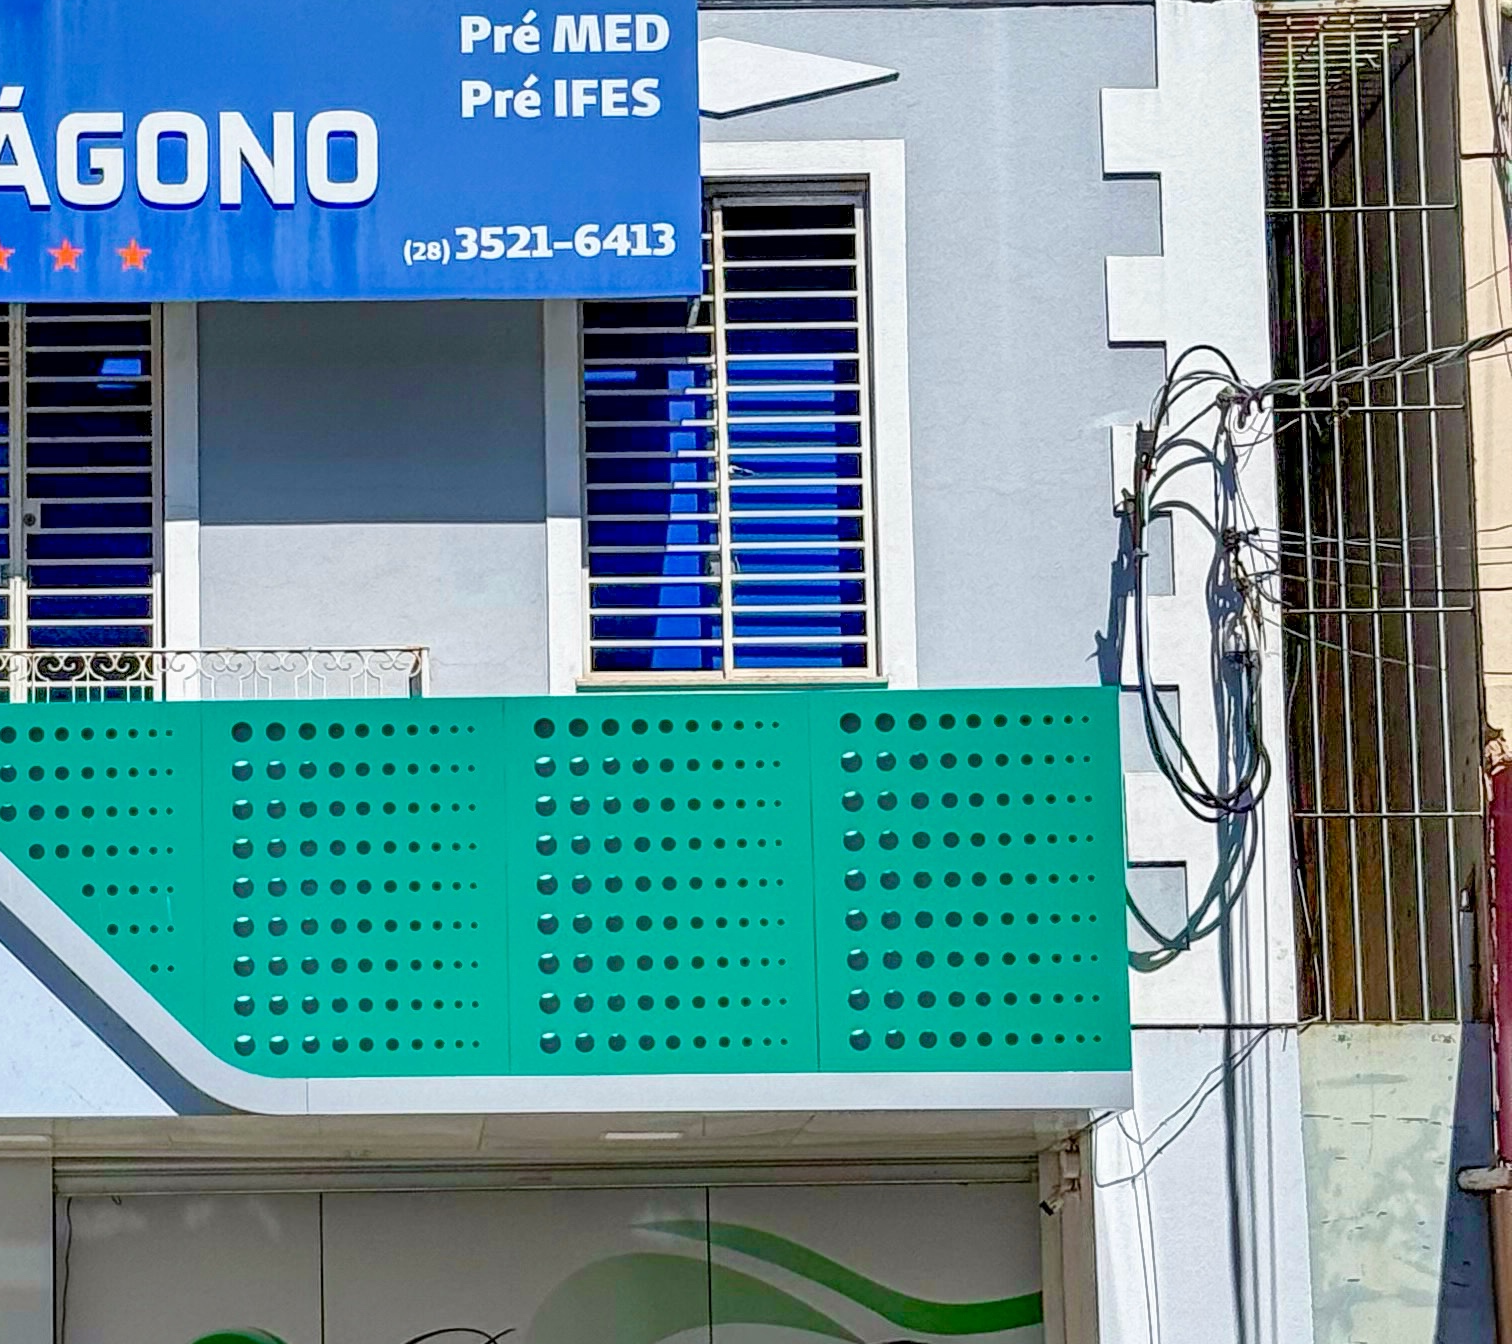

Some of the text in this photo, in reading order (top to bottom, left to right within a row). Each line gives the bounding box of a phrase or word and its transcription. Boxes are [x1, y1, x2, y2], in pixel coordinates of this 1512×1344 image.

[460, 10, 670, 54] Pré MED
[461, 74, 662, 118] Pré IFES
[403, 223, 677, 266] (28) 3521-6413
